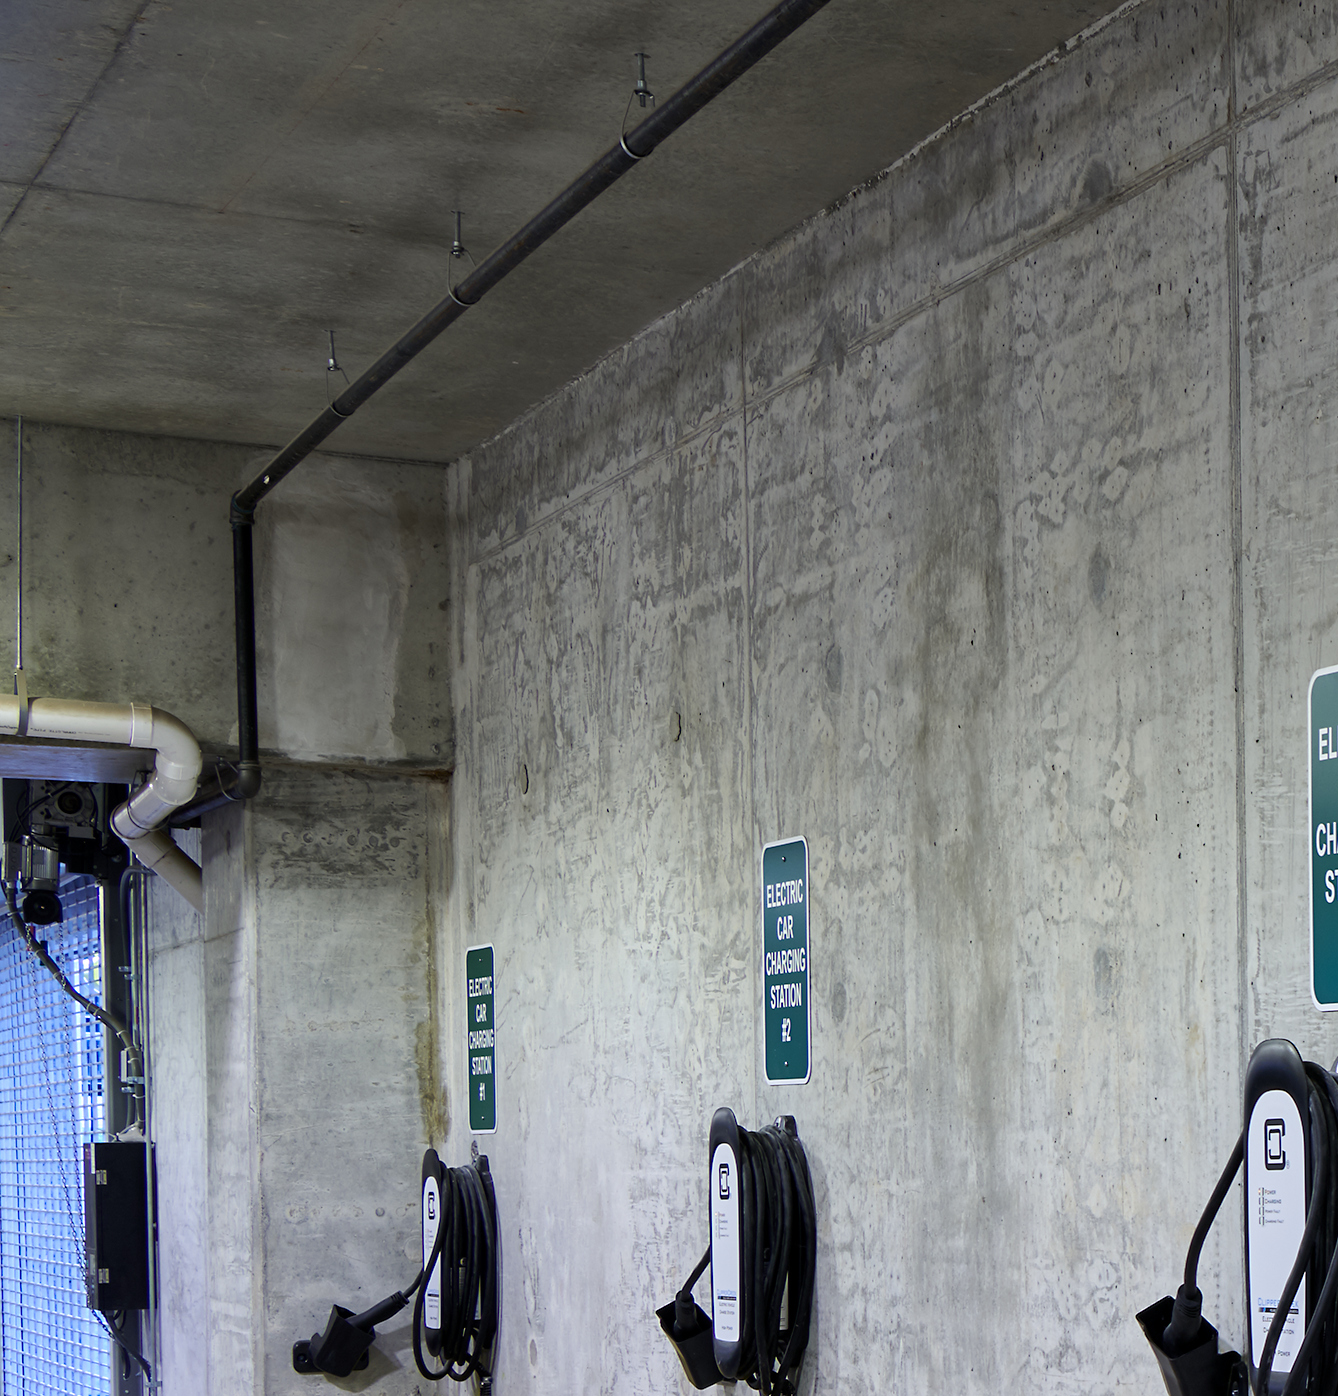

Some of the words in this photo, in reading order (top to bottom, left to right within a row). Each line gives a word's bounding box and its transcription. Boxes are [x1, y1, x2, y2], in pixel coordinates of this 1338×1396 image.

[766, 878, 804, 908] ELECTRIC
[776, 915, 794, 941] CAR
[765, 947, 806, 976] CHARGING
[468, 975, 493, 997] ELECTRIC
[770, 982, 802, 1010] STATION
[475, 1003, 487, 1023] CAR
[468, 1028, 495, 1050] CHARGING
[781, 1018, 792, 1043] #2
[471, 1055, 493, 1076] STATION
